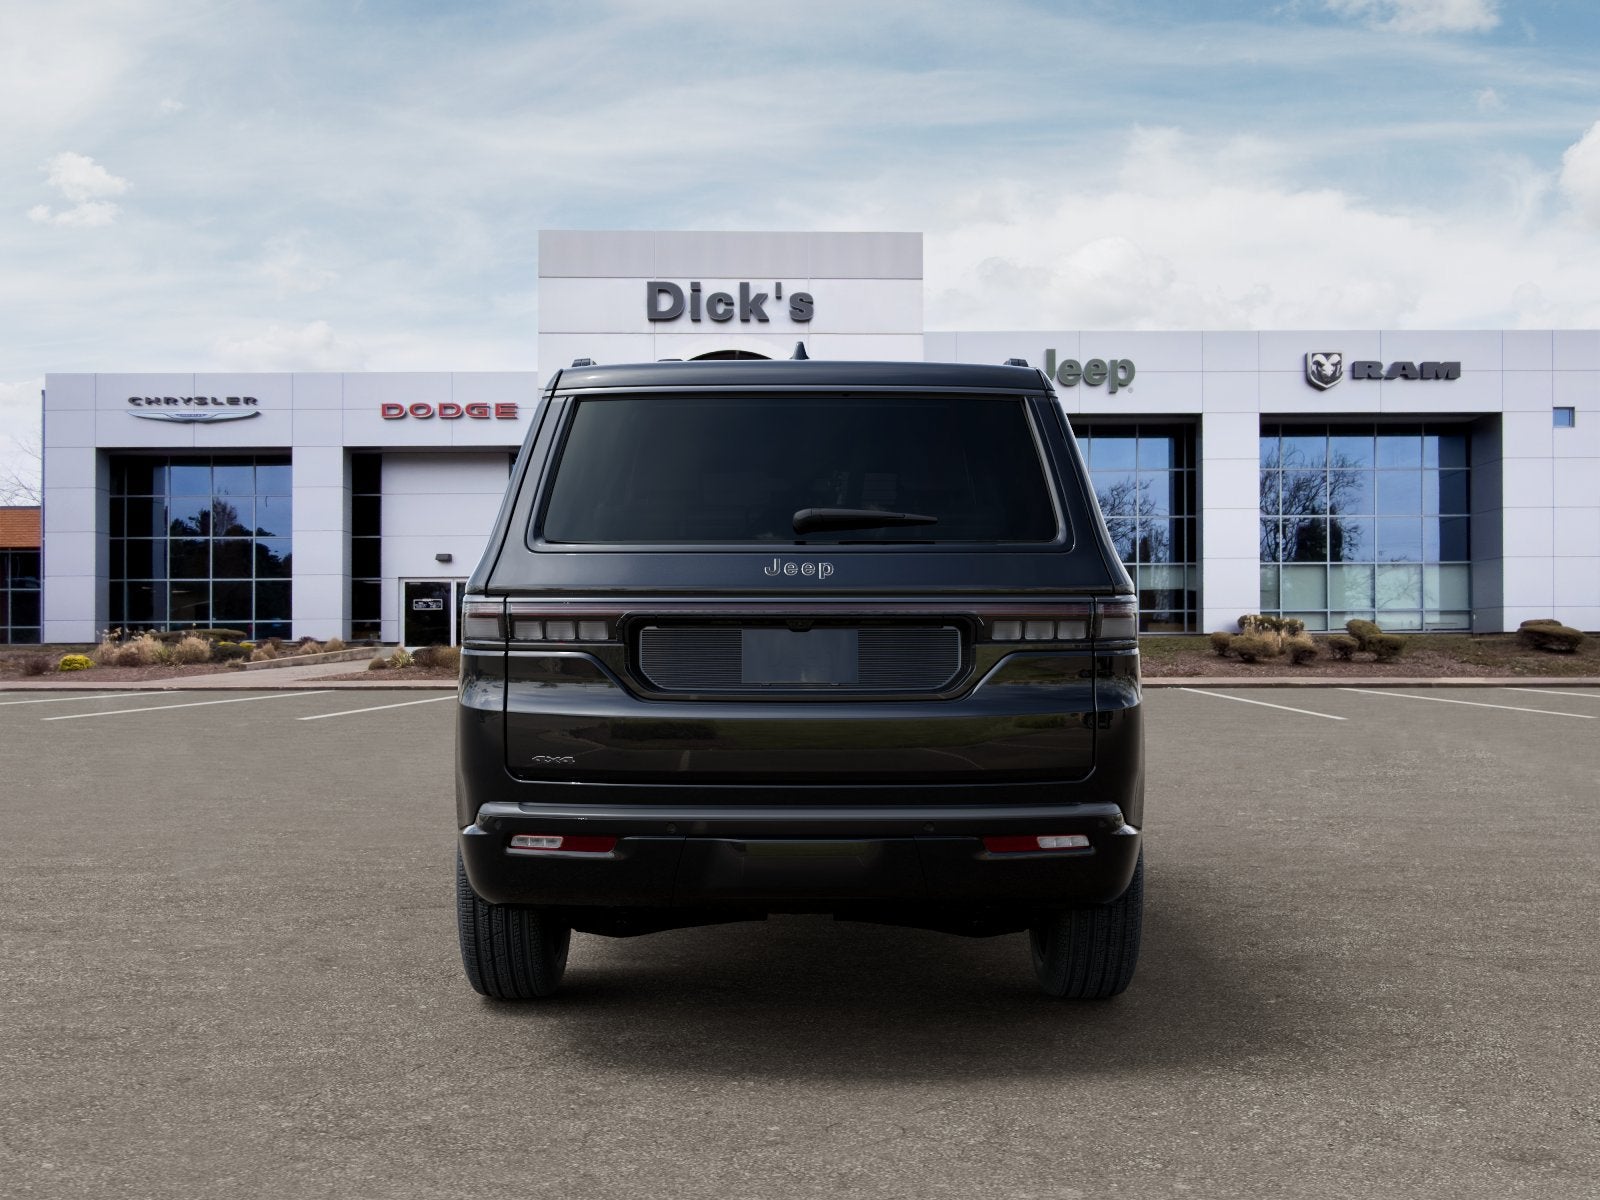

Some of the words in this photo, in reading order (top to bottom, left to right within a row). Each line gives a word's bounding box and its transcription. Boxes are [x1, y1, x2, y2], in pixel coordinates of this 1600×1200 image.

[647, 281, 814, 323] Dick's
[1352, 361, 1461, 380] RAM
[127, 396, 258, 406] CHRYSLER
[381, 402, 518, 420] DODGE
[764, 558, 834, 580] Jeep
